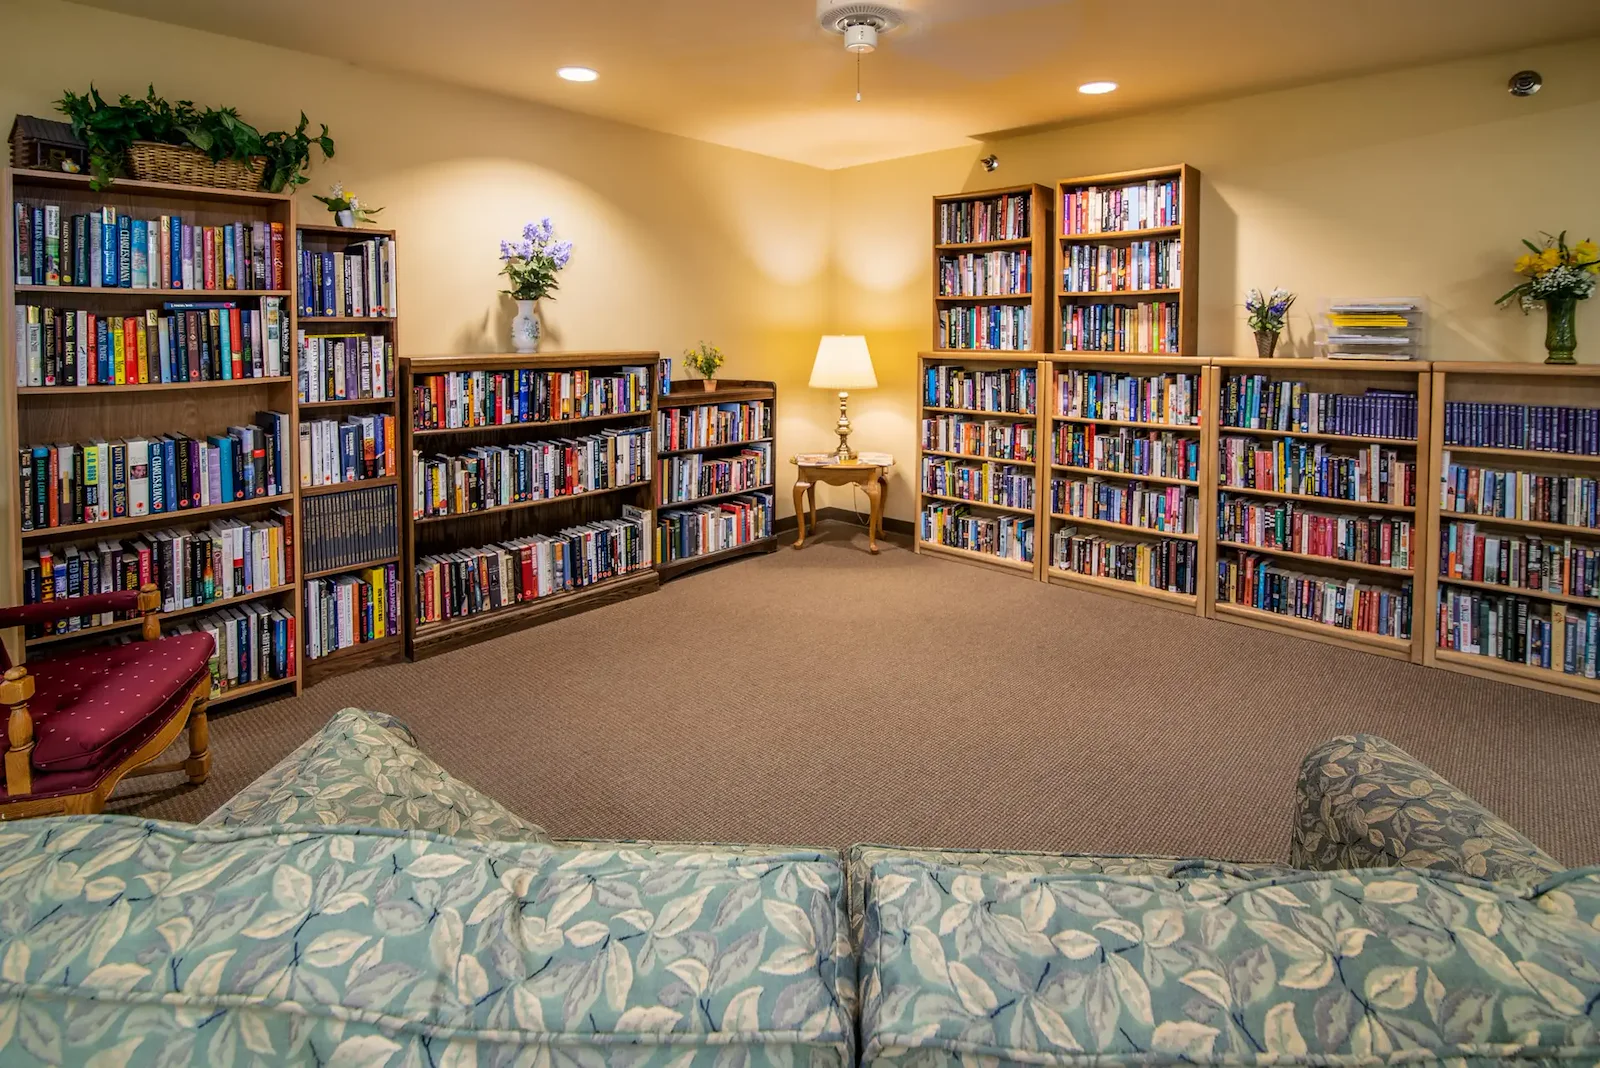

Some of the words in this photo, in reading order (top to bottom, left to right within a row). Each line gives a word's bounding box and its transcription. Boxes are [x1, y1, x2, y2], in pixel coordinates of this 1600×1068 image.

[120, 230, 130, 256] CHARLES
[120, 262, 130, 282] DIANA
[87, 451, 97, 466] J.D.
[115, 447, 123, 463] KITTY
[180, 441, 188, 458] JAMES
[87, 466, 97, 481] ROBB
[115, 464, 123, 481] KELLEY
[152, 456, 162, 483] CHARLES
[180, 458, 188, 482] STEWART
[69, 559, 80, 573] TED
[69, 574, 80, 593] BELL
[262, 633, 271, 655] GRIFTER
